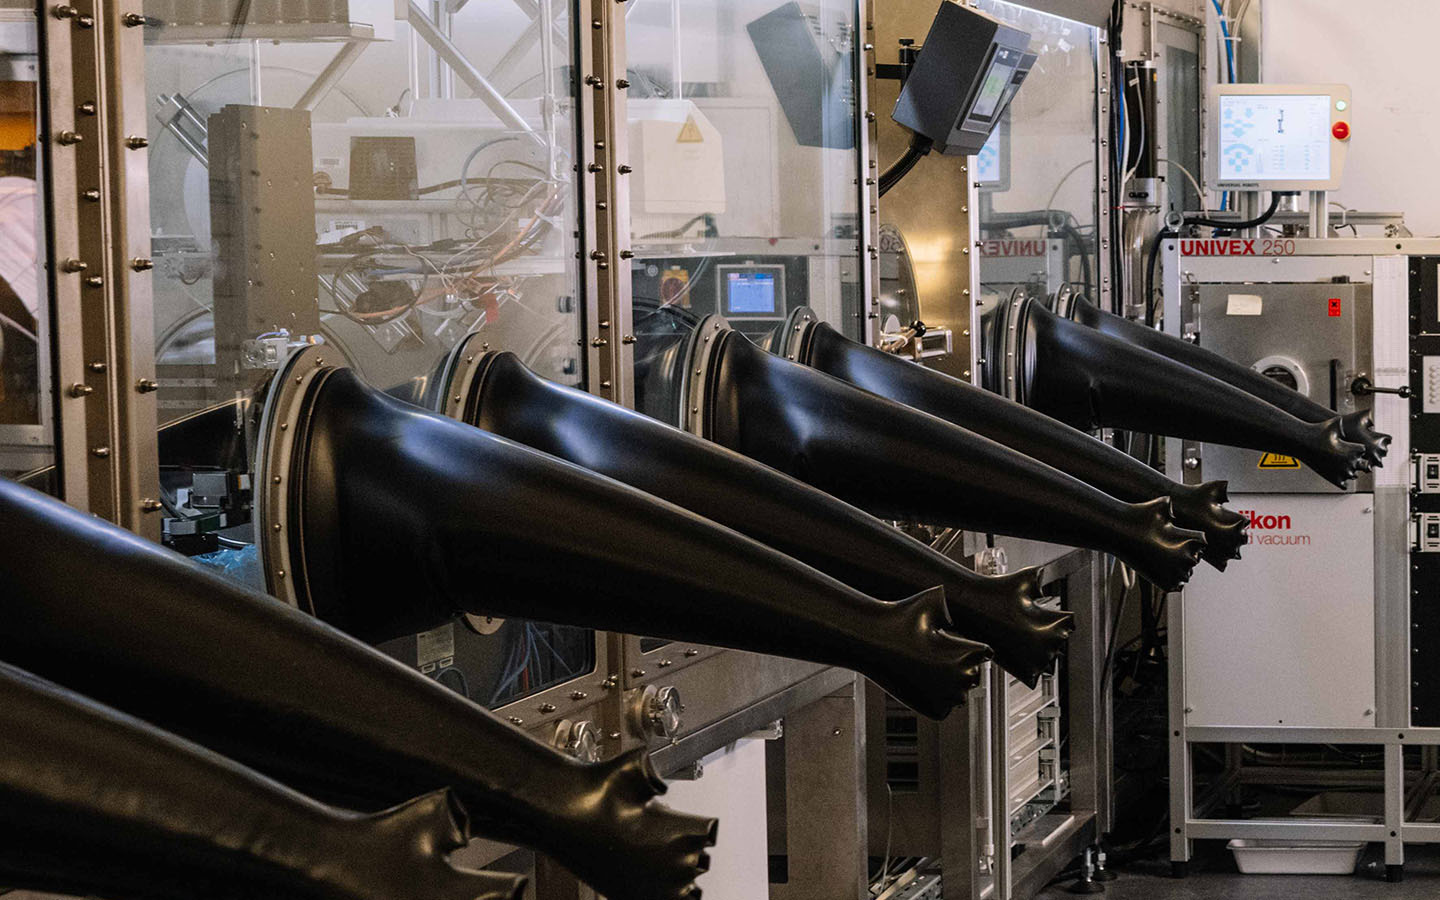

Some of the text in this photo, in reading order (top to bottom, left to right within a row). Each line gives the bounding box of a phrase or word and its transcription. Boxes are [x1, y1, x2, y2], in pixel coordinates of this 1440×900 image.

[1180, 239, 1296, 256] UNIVEX 250
[1256, 534, 1311, 545] vacuum
